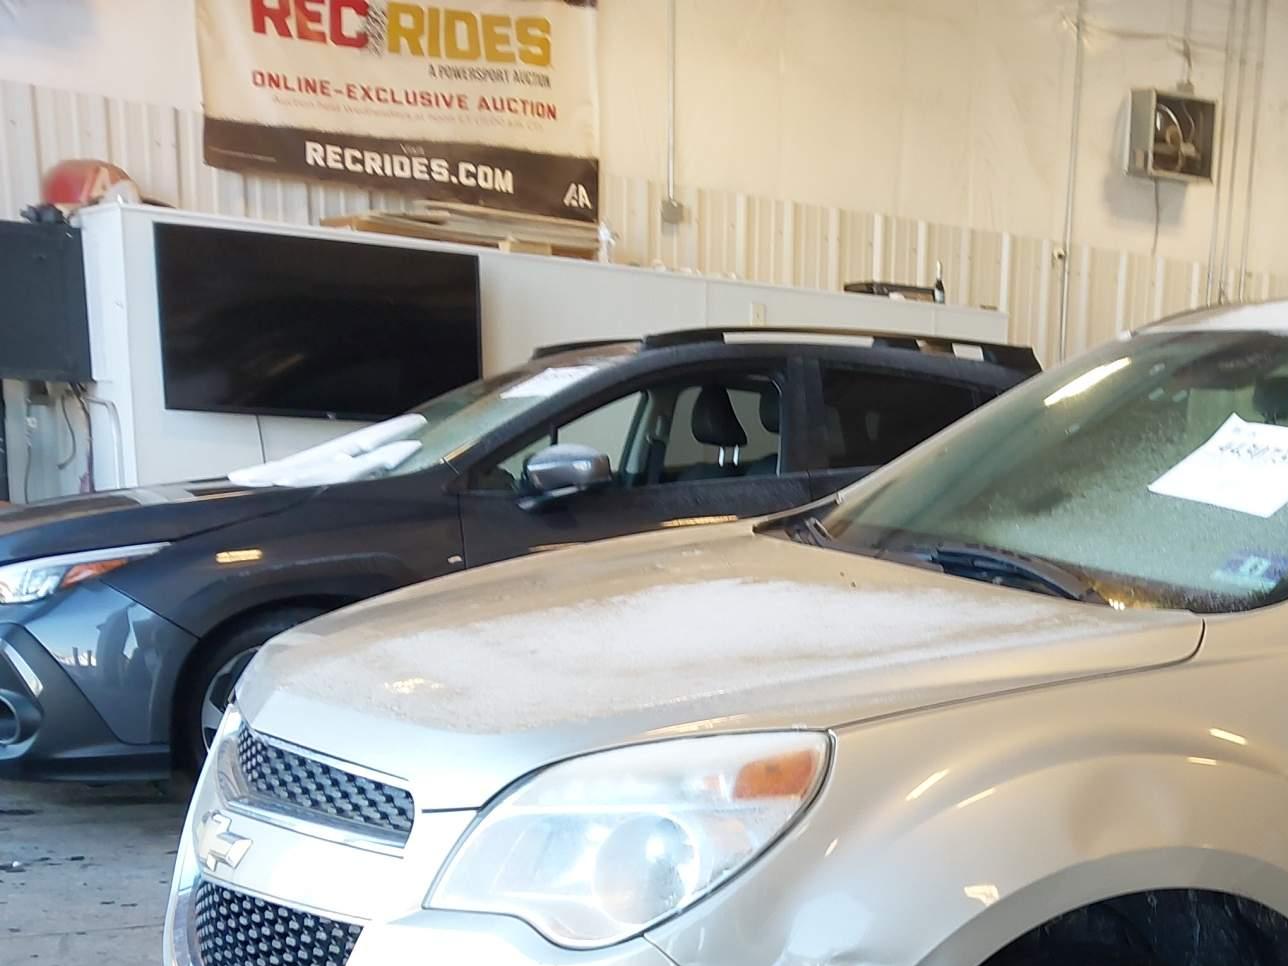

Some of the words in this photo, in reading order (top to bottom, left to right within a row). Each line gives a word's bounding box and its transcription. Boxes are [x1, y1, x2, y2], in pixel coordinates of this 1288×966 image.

[251, 0, 369, 48] REC
[387, 2, 552, 66] RIDES
[252, 70, 468, 111] ONLINE-EXCLUSIVE
[478, 95, 558, 120] AUCTION
[305, 141, 514, 194] RECRIDES.COM
